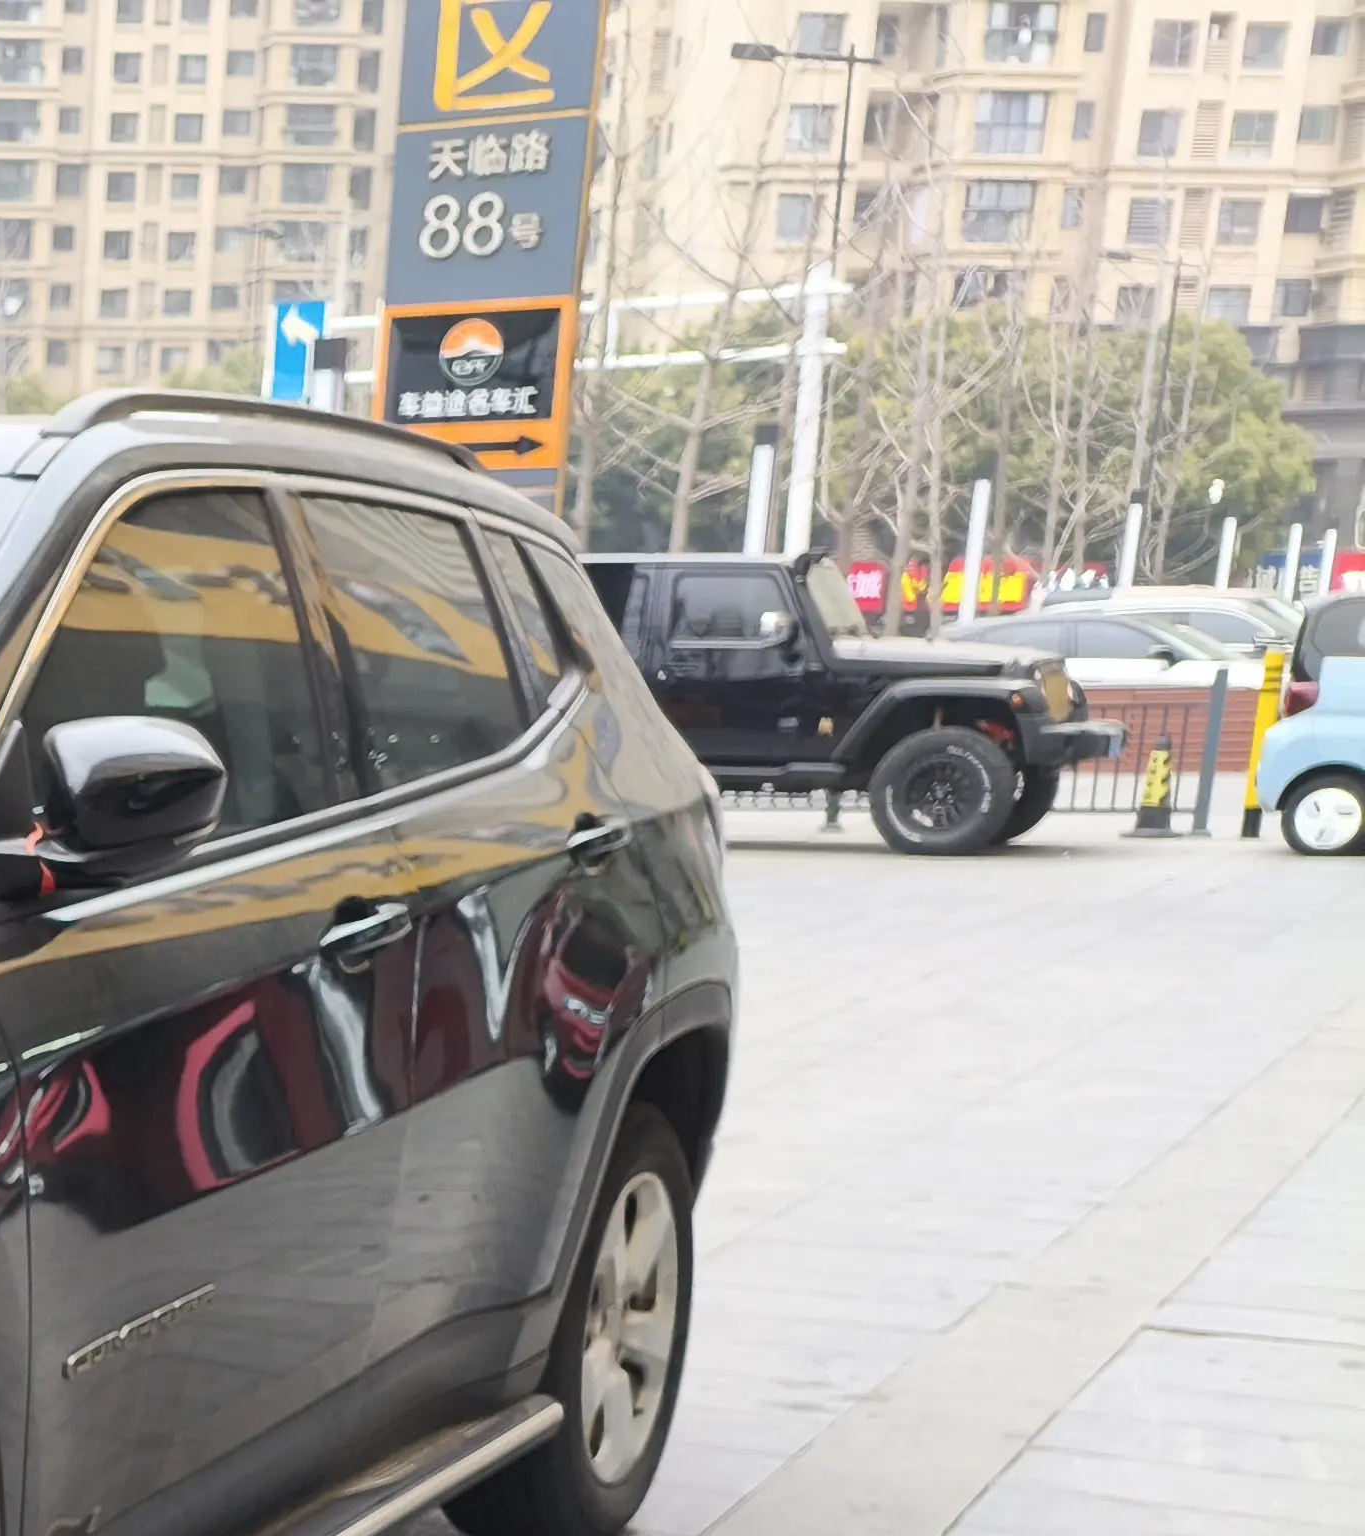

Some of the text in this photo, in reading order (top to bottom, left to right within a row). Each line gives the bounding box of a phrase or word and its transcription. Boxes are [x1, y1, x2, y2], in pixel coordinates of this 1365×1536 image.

[433, 0, 555, 112] 区
[427, 128, 551, 182] 天临路
[418, 190, 544, 260] 88号
